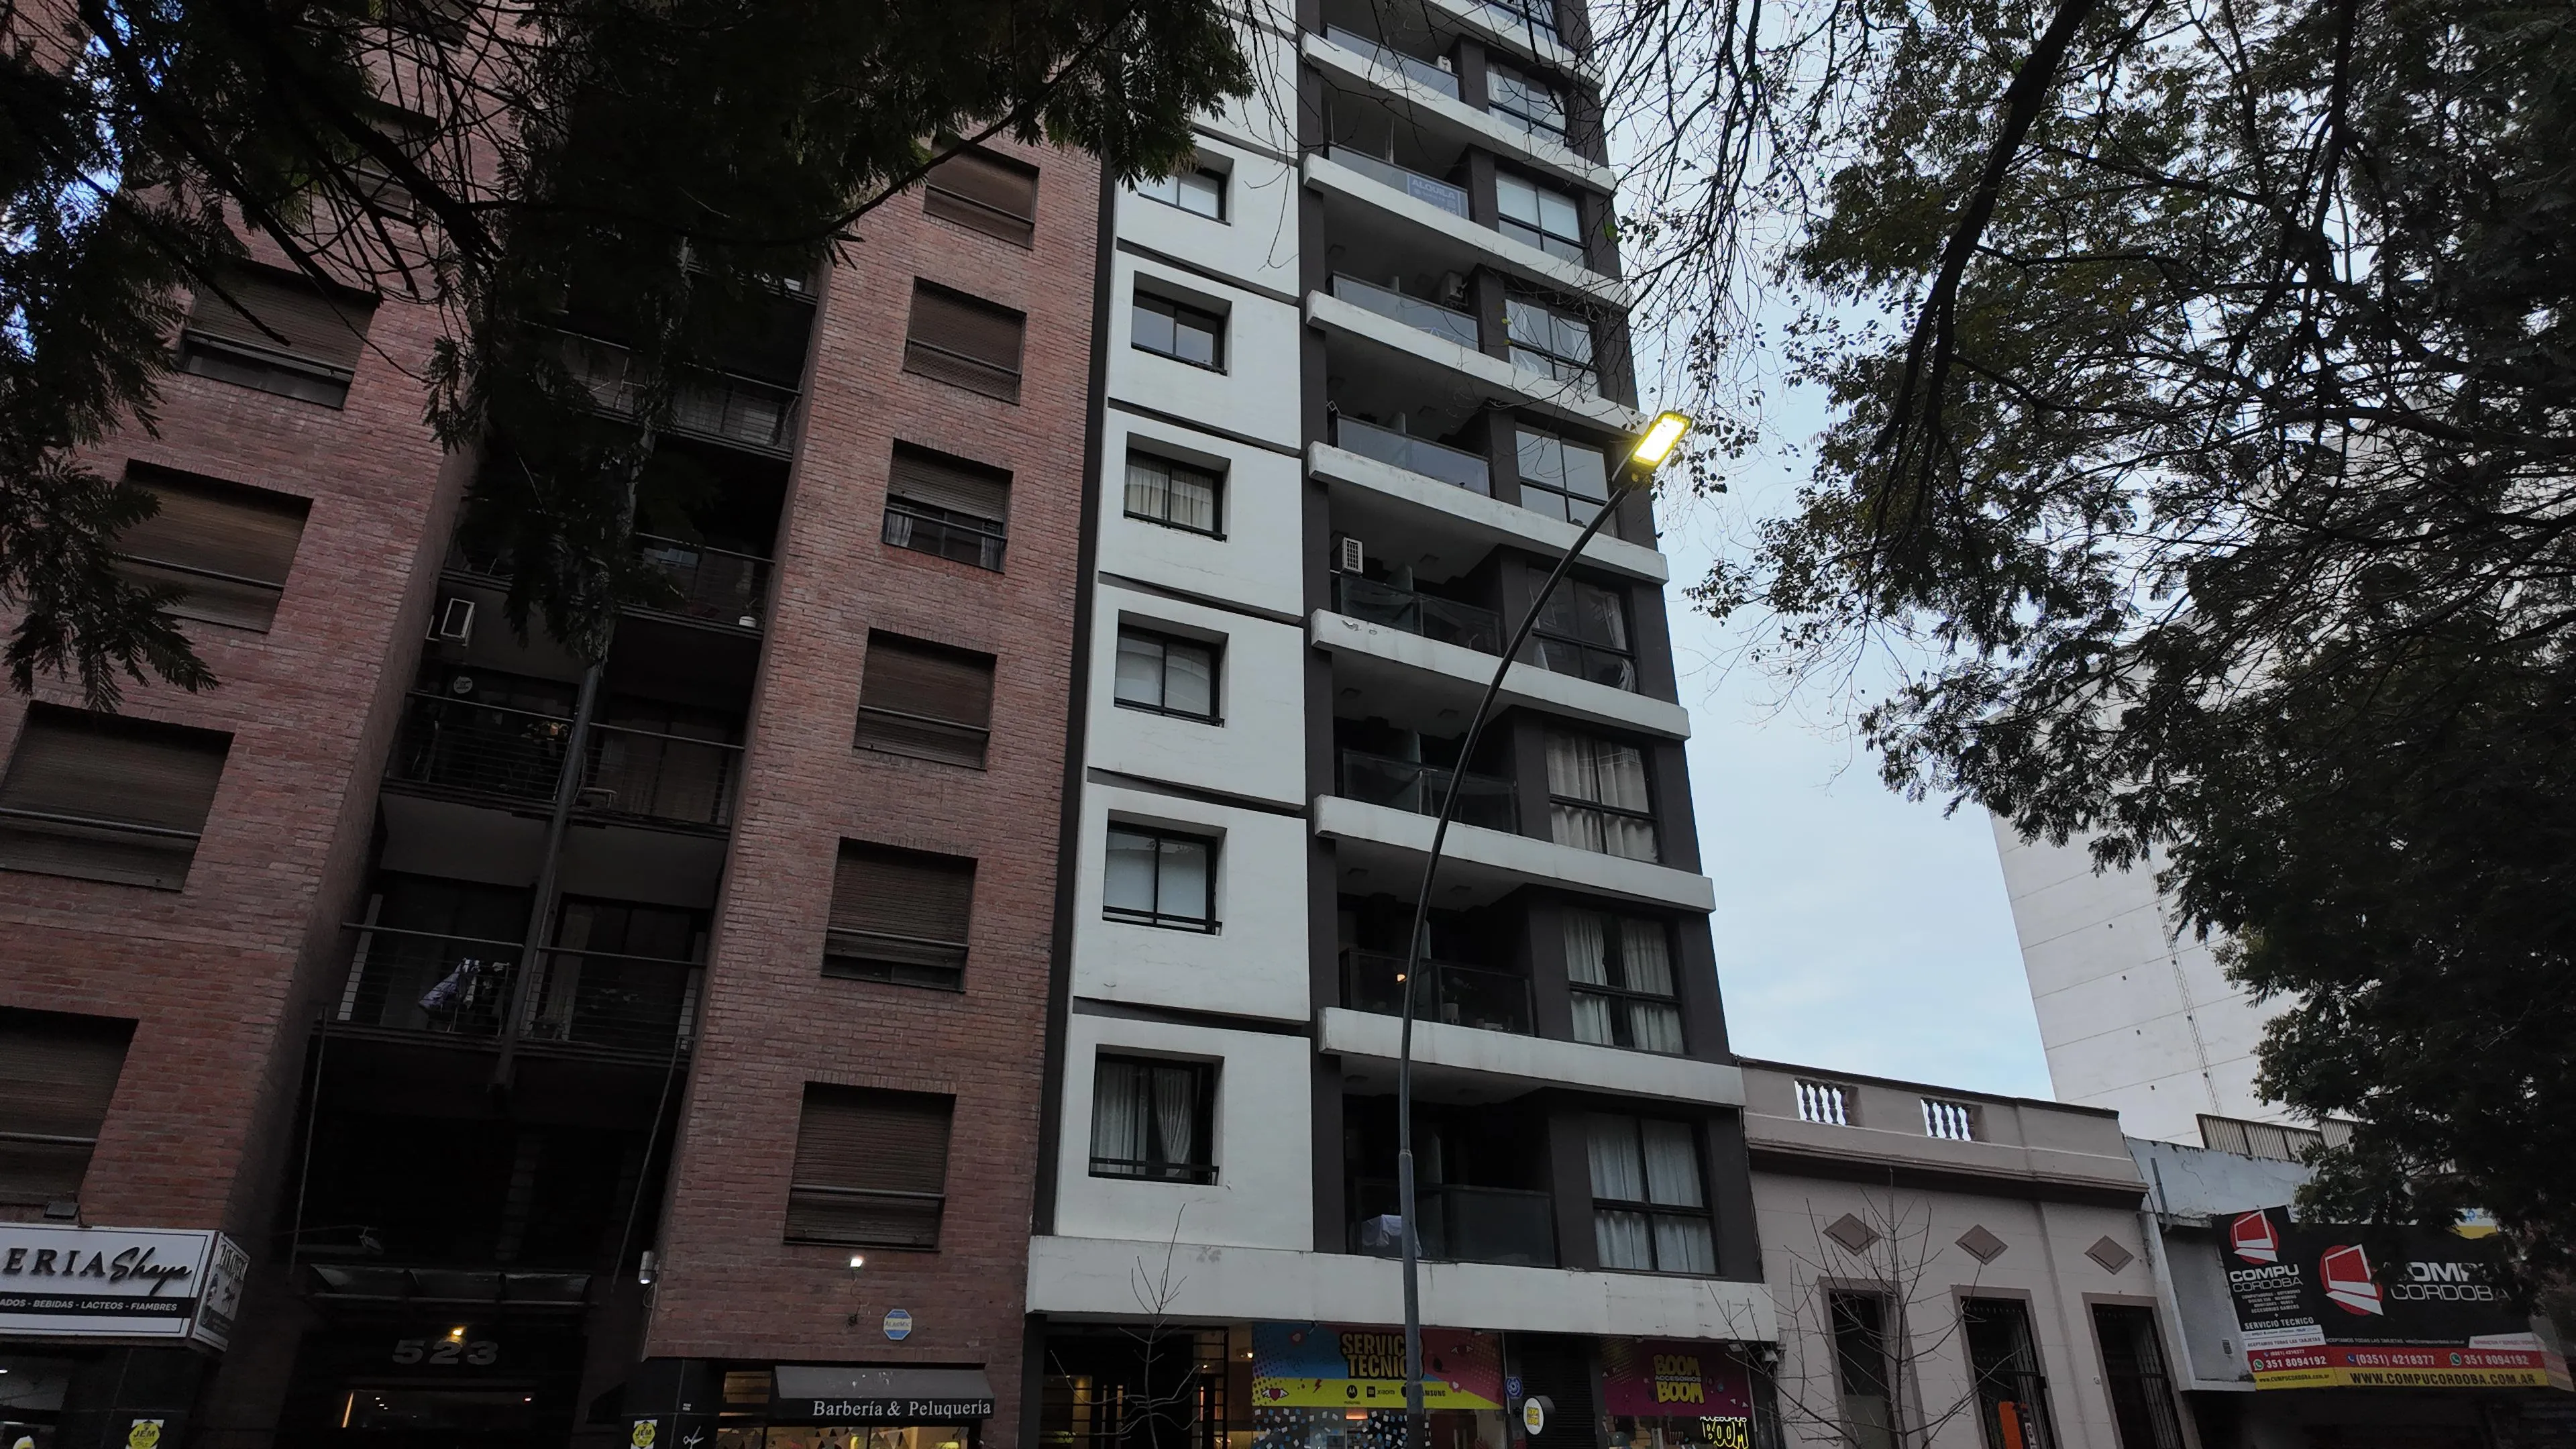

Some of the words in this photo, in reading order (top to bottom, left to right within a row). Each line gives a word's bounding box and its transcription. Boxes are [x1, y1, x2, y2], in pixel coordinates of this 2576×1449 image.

[1411, 179, 1456, 200] ALQUILA
[3, 1248, 105, 1277] ERIA
[2229, 1264, 2300, 1282] COMPU
[2232, 1277, 2304, 1293] CORDOBA
[33, 1299, 74, 1309] BEBIDAS
[80, 1301, 124, 1310] LACTEOS
[130, 1302, 178, 1311] FIAMBRES
[2244, 1320, 2279, 1330] SERVICIO
[2281, 1317, 2314, 1327] TECNICO
[392, 1340, 499, 1365] 523
[1342, 1333, 1423, 1356] SERVIC
[1346, 1354, 1423, 1378] TECNIC
[1653, 1354, 1701, 1377] BOOM
[2265, 1358, 2283, 1368] 351
[2285, 1355, 2327, 1367] 8094192
[2355, 1354, 2390, 1366] (0351)
[2392, 1354, 2435, 1365] 4218377
[2464, 1354, 2483, 1364] 351
[2485, 1354, 2530, 1365] 8094192
[2349, 1372, 2536, 1385] WWW.COMPUCORDOBA.COM.AR
[1655, 1381, 1705, 1404] BOOM
[812, 1400, 883, 1416] Barbería
[886, 1401, 902, 1416] &
[908, 1399, 991, 1419] Peluquería
[133, 1430, 156, 1438] JEM
[1701, 1421, 1749, 1449] BOOM
